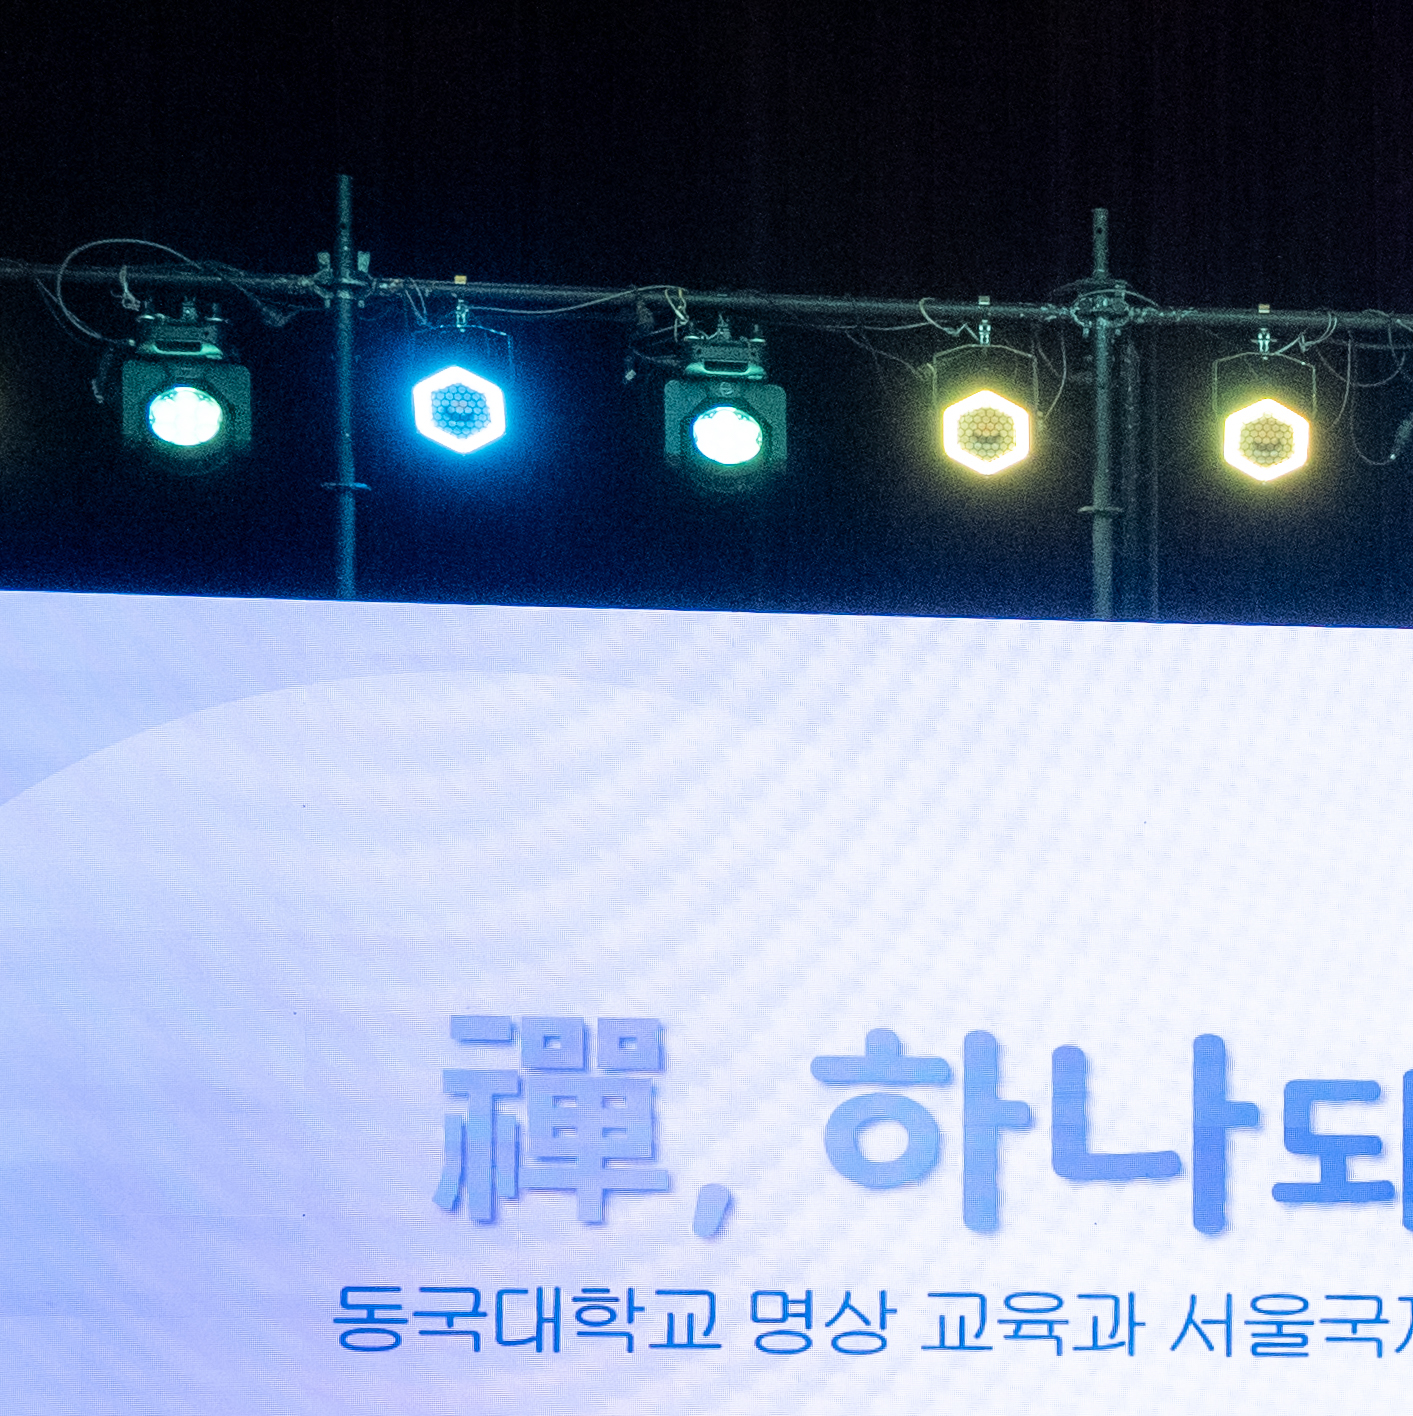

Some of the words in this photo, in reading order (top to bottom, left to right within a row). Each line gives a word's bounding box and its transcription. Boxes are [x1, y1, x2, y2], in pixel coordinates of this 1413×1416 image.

[333, 1285, 723, 1356] 동국대학교
[749, 1287, 898, 1357] 명상
[921, 1290, 1147, 1359] 교육과
